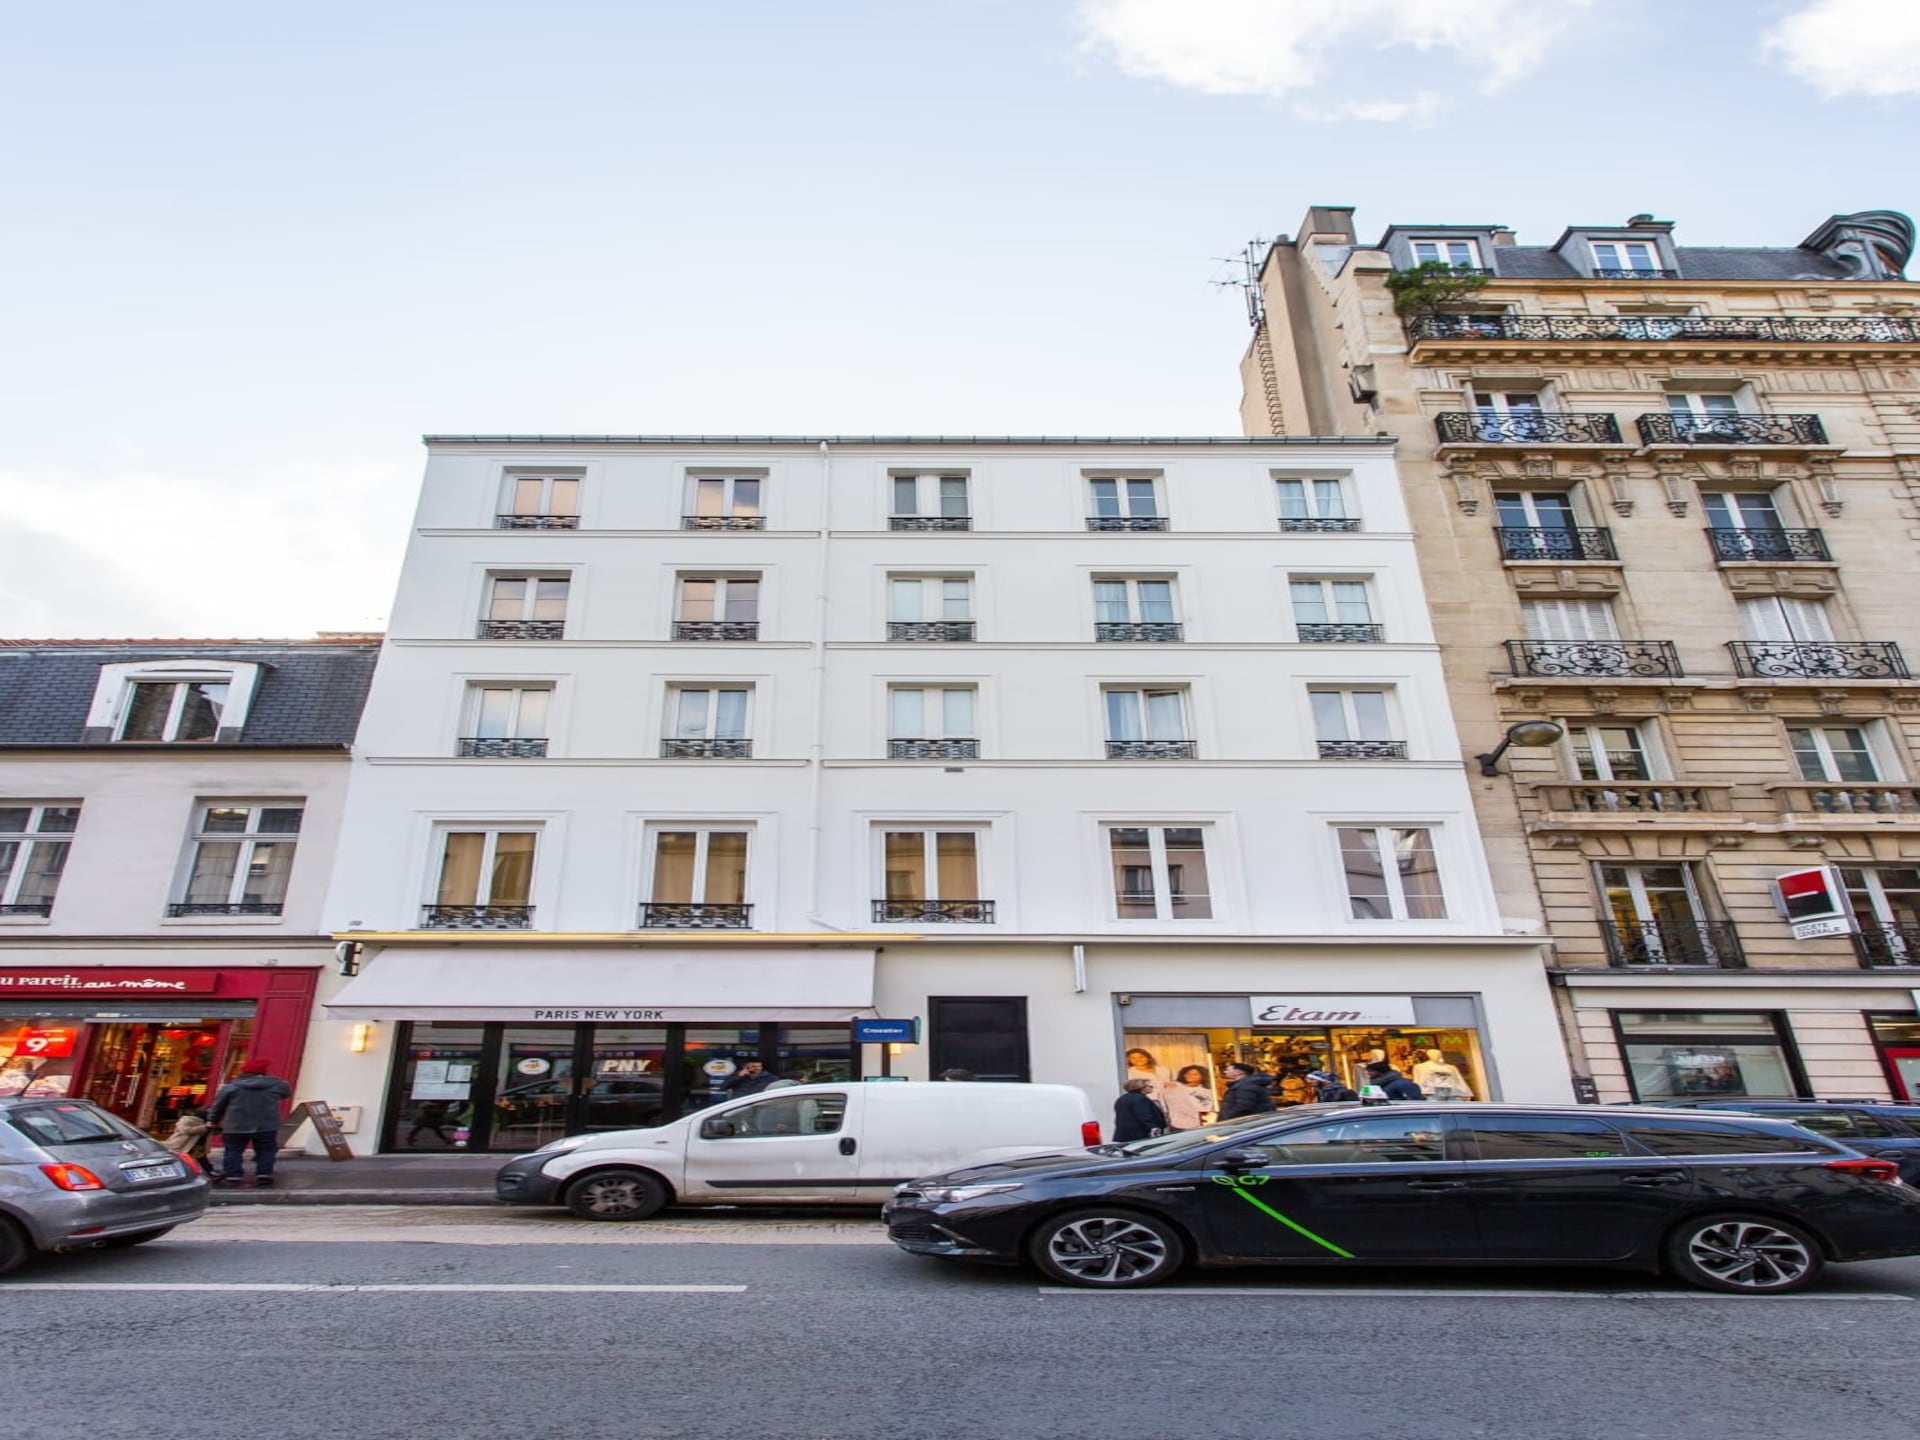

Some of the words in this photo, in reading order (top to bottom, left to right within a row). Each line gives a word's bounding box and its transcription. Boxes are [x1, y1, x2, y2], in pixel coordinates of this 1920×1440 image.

[118, 978, 186, 990] même
[534, 1010, 579, 1019] PARIS
[584, 1010, 618, 1019] NEW
[623, 1010, 663, 1019] YORK
[1258, 1004, 1362, 1022] Etam
[602, 1059, 651, 1072] PNY
[1238, 1175, 1271, 1185] G7
